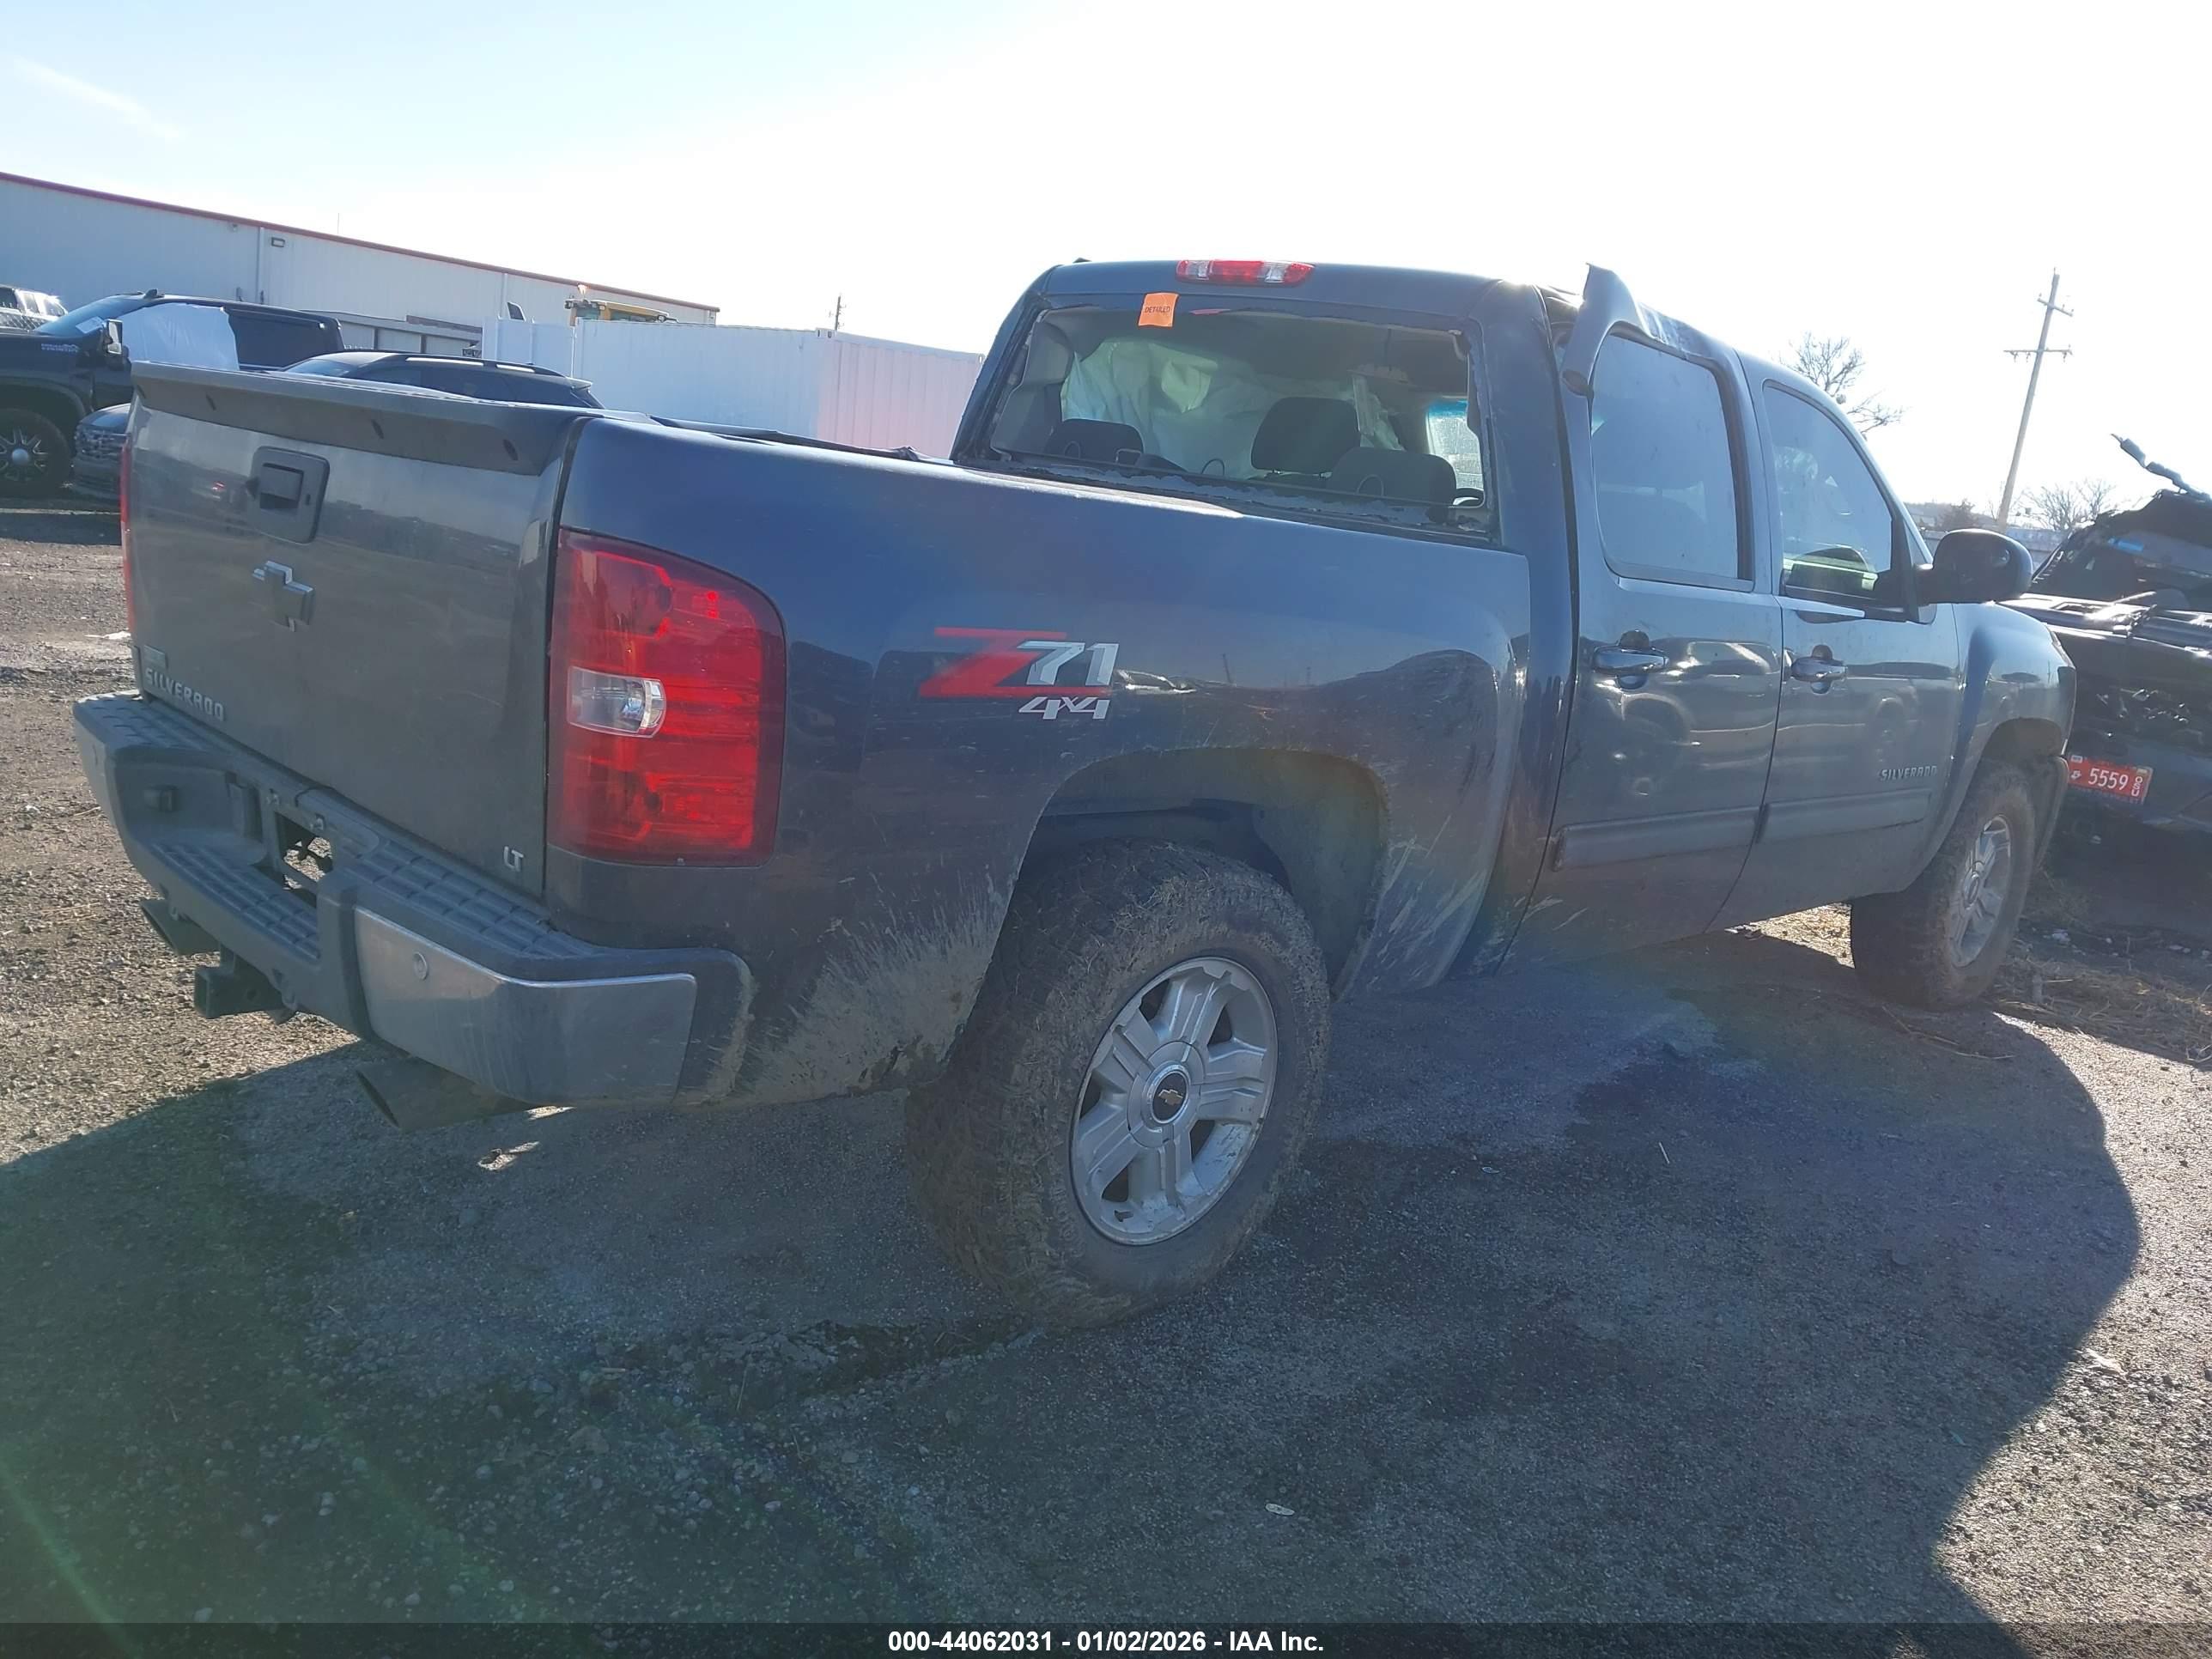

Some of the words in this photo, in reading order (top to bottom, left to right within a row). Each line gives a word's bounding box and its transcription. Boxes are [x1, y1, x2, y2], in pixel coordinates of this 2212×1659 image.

[920, 627, 1120, 697] Z71
[145, 667, 225, 722] SILVERADO
[1881, 765, 1938, 781] SILVERADO
[2087, 767, 2129, 791] 5559
[2130, 775, 2143, 797] OSU
[503, 846, 524, 872] LT
